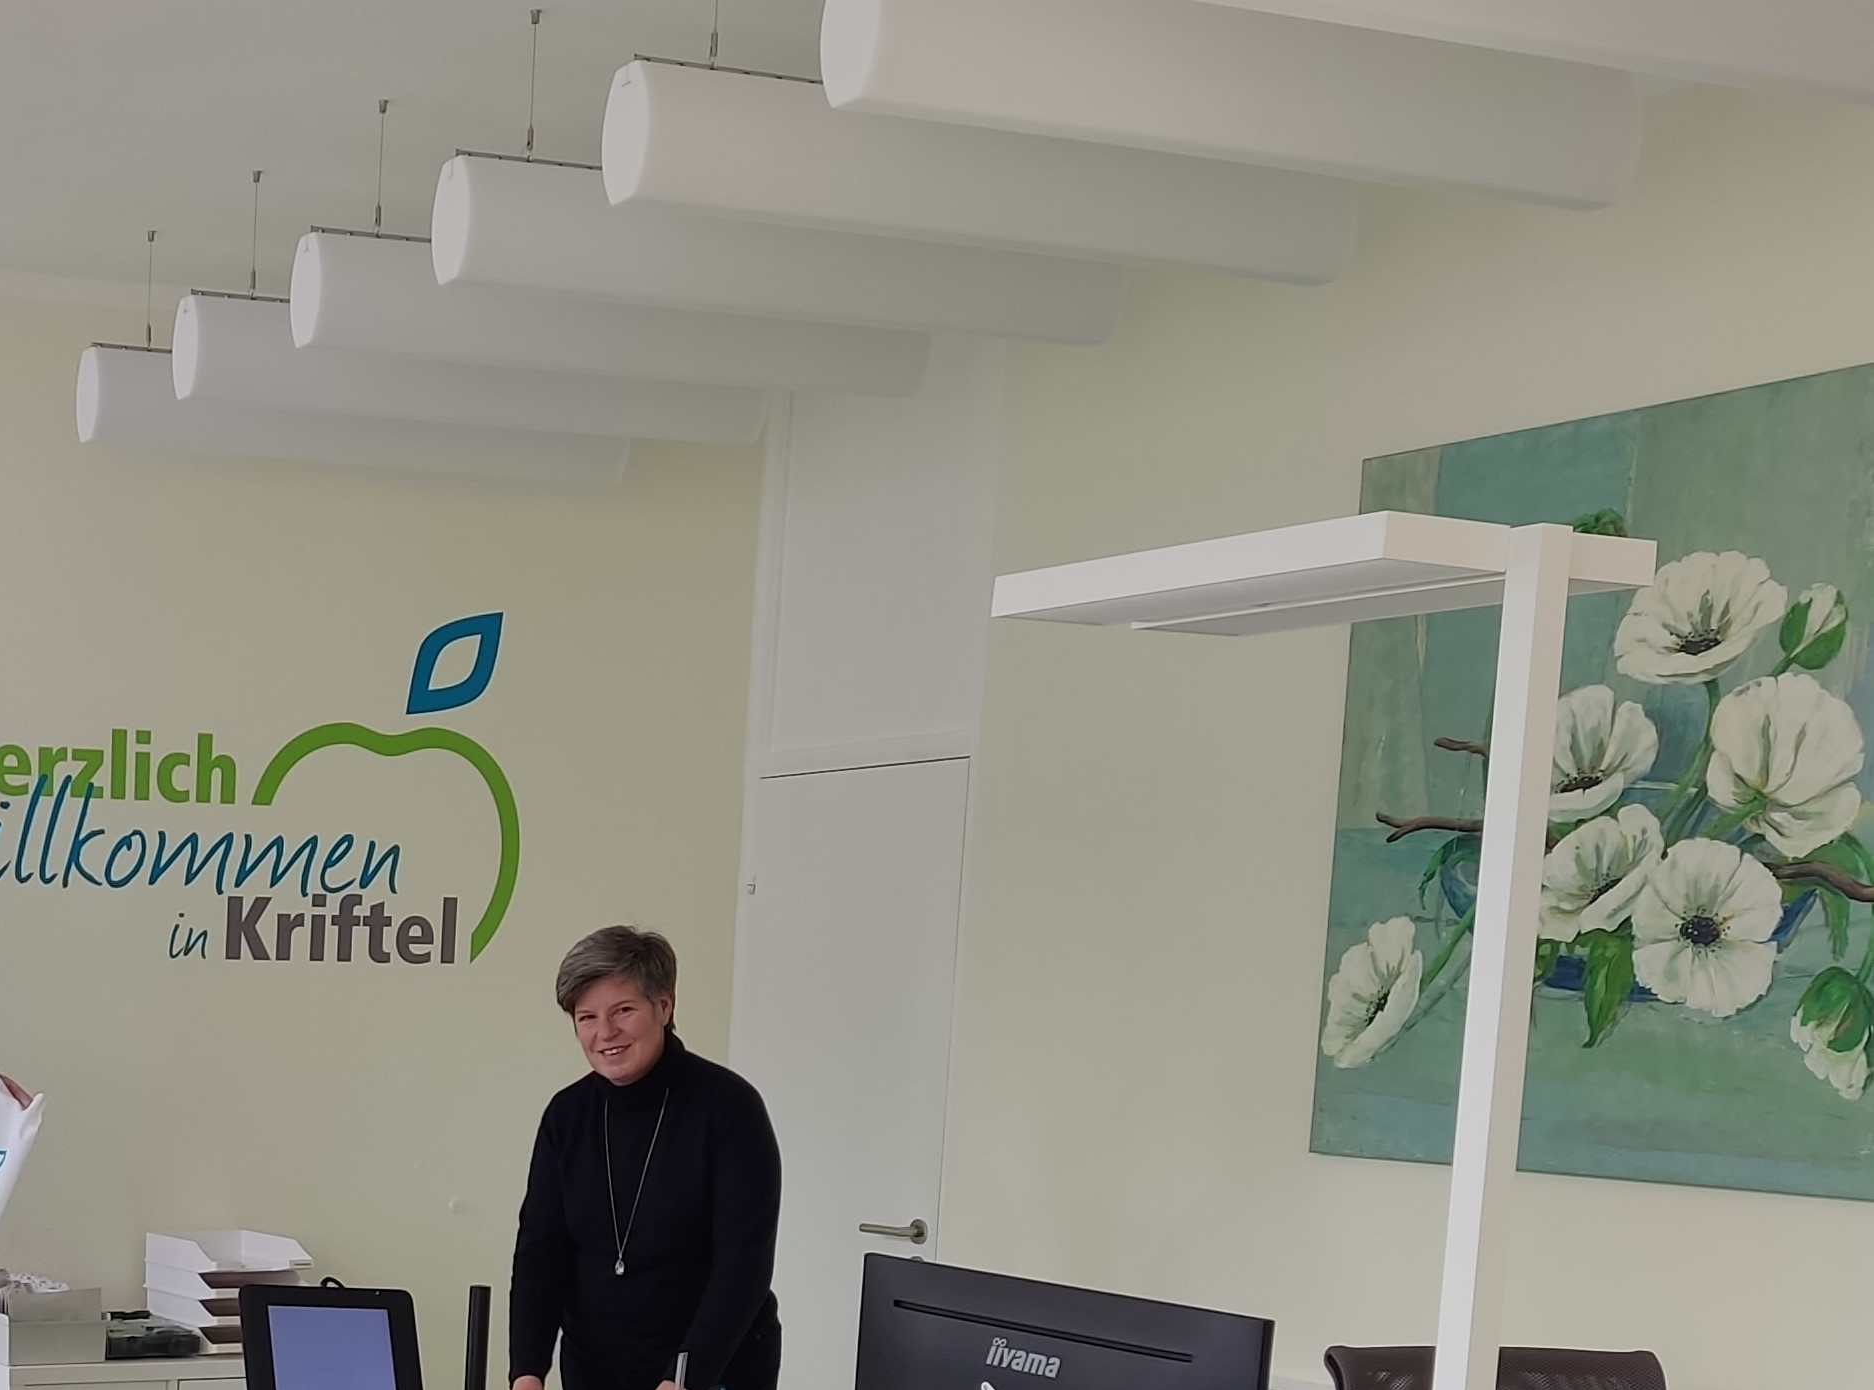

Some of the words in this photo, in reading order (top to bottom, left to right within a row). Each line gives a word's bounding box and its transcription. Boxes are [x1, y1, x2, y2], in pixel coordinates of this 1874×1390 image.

[168, 912, 207, 960] in
[225, 894, 458, 965] Kriftel
[986, 1337, 1061, 1378] iiyama
